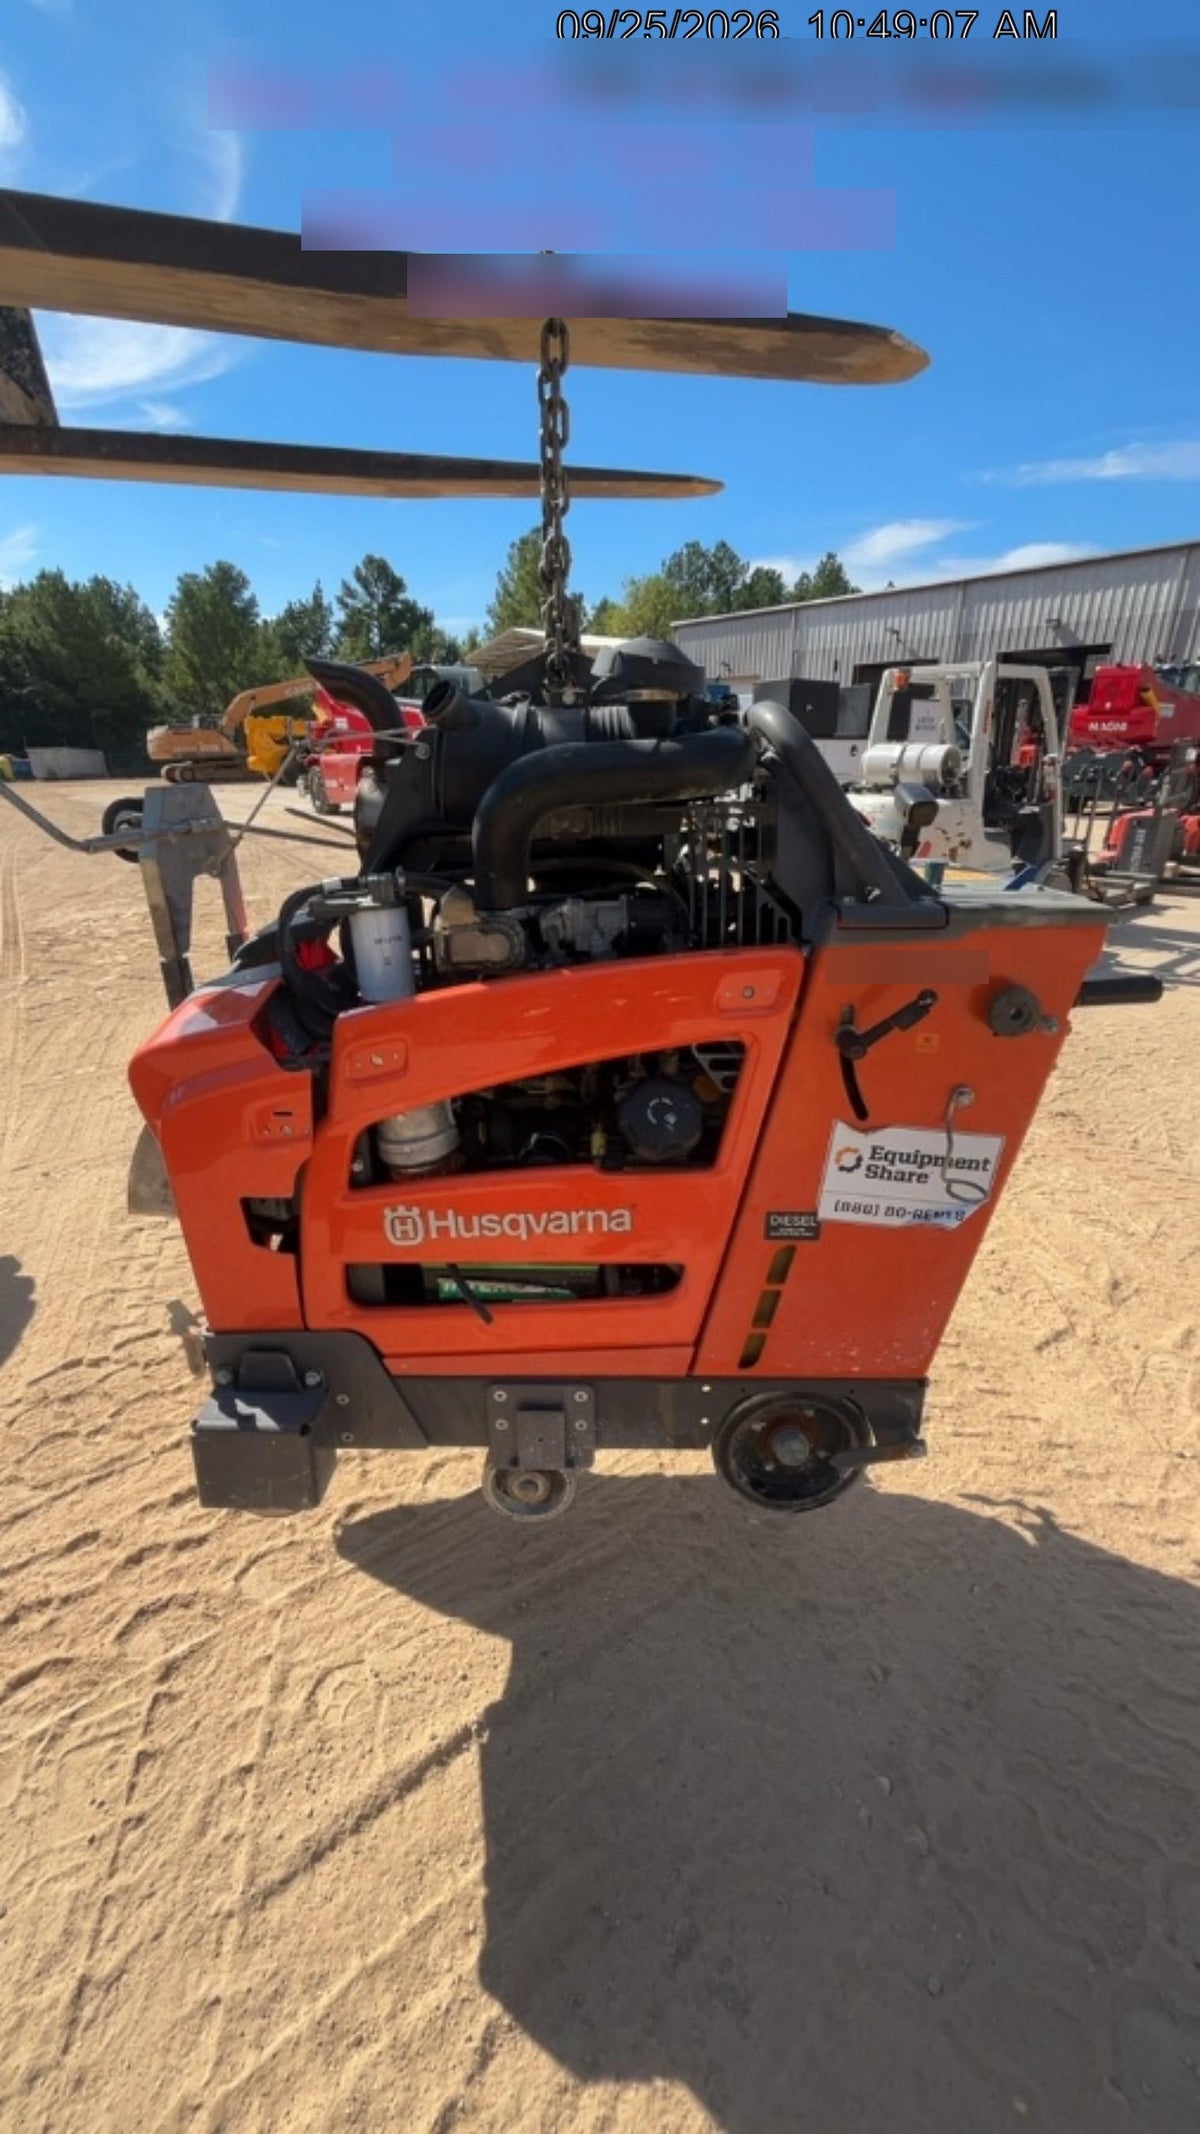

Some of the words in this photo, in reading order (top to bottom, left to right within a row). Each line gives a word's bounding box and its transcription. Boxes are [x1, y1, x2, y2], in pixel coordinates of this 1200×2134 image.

[868, 1145, 991, 1172] Equipment
[865, 1164, 930, 1184] Share
[428, 1208, 632, 1241] Husqvarna
[770, 1214, 817, 1226] DIESEL
